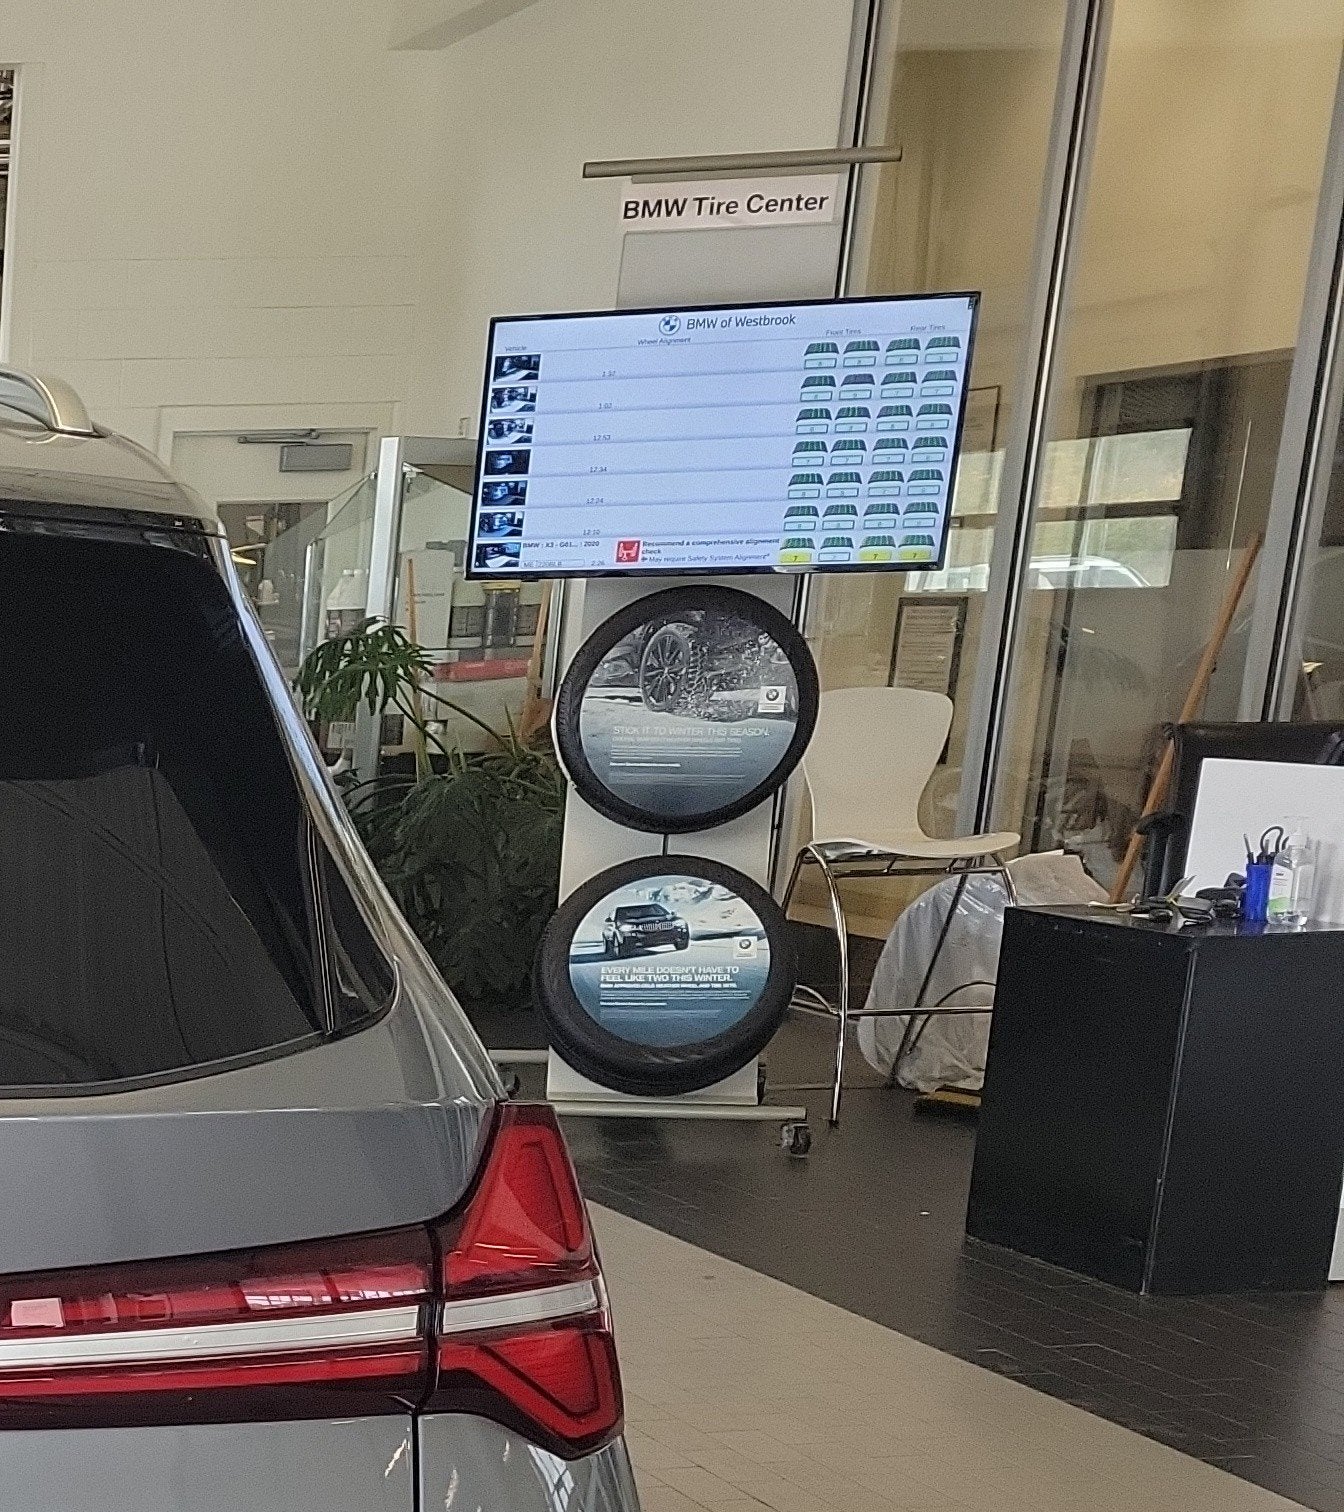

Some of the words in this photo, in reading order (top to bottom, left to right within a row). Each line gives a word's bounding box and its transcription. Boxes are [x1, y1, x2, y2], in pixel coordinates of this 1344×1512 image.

[623, 197, 688, 220] BMW
[693, 196, 739, 216] Tire
[746, 193, 830, 214] Center
[687, 317, 718, 330] BMW
[720, 316, 733, 328] of
[735, 314, 796, 328] Westbrook
[659, 337, 692, 346] Alignment
[745, 538, 780, 546] alignment
[710, 554, 734, 562] System
[614, 727, 640, 735] STICK
[642, 727, 651, 735] IT
[653, 727, 666, 735] TO
[670, 727, 704, 736] WINTER
[708, 728, 728, 736] THIS
[601, 966, 631, 974] EVERY
[633, 966, 655, 974] MILE
[656, 966, 697, 974] DOESN'T
[699, 966, 724, 974] HAVE
[726, 966, 740, 974] TO
[600, 974, 624, 982] FEEL
[625, 974, 646, 982] LIKE
[647, 974, 670, 982] TWO
[672, 974, 692, 982] THIS
